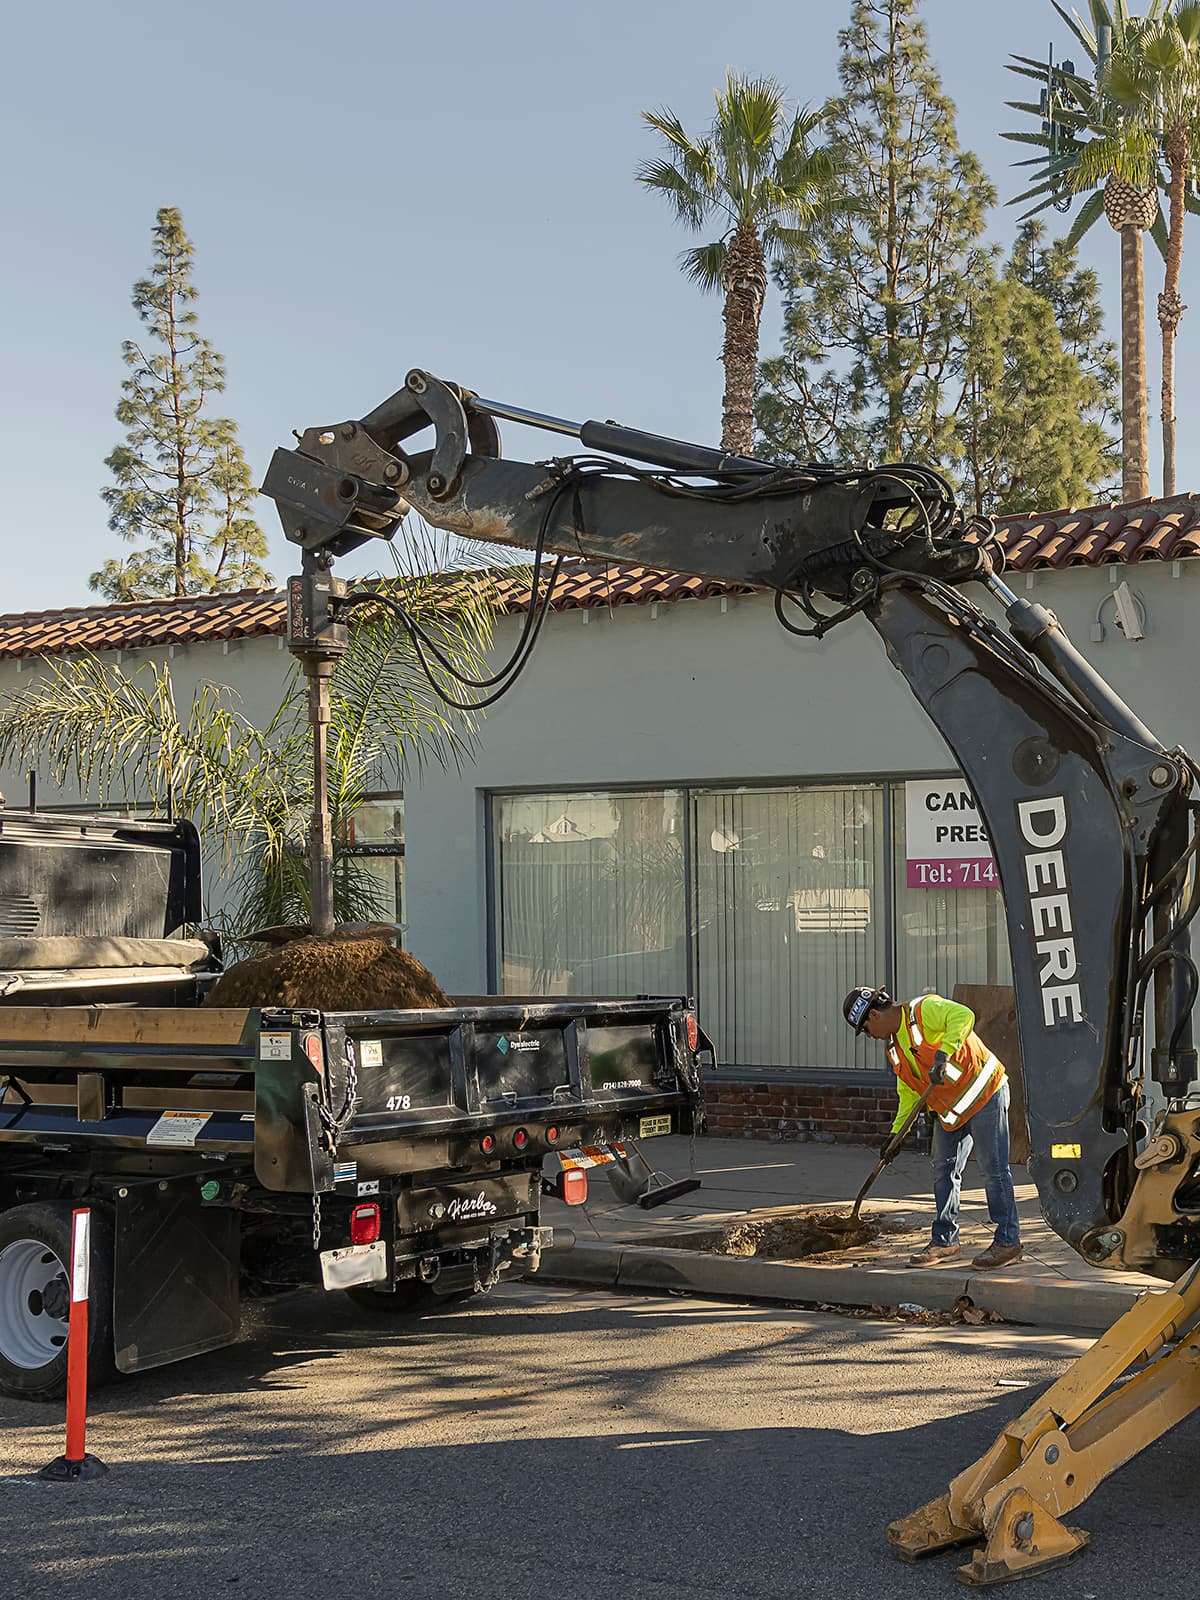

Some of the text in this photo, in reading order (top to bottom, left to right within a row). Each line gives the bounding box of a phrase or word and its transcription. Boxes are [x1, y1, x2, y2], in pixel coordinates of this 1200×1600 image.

[915, 863, 952, 883] Tel:
[1018, 796, 1084, 1026] DEERE
[386, 1095, 411, 1110] 478
[447, 1191, 497, 1220] Harbor
